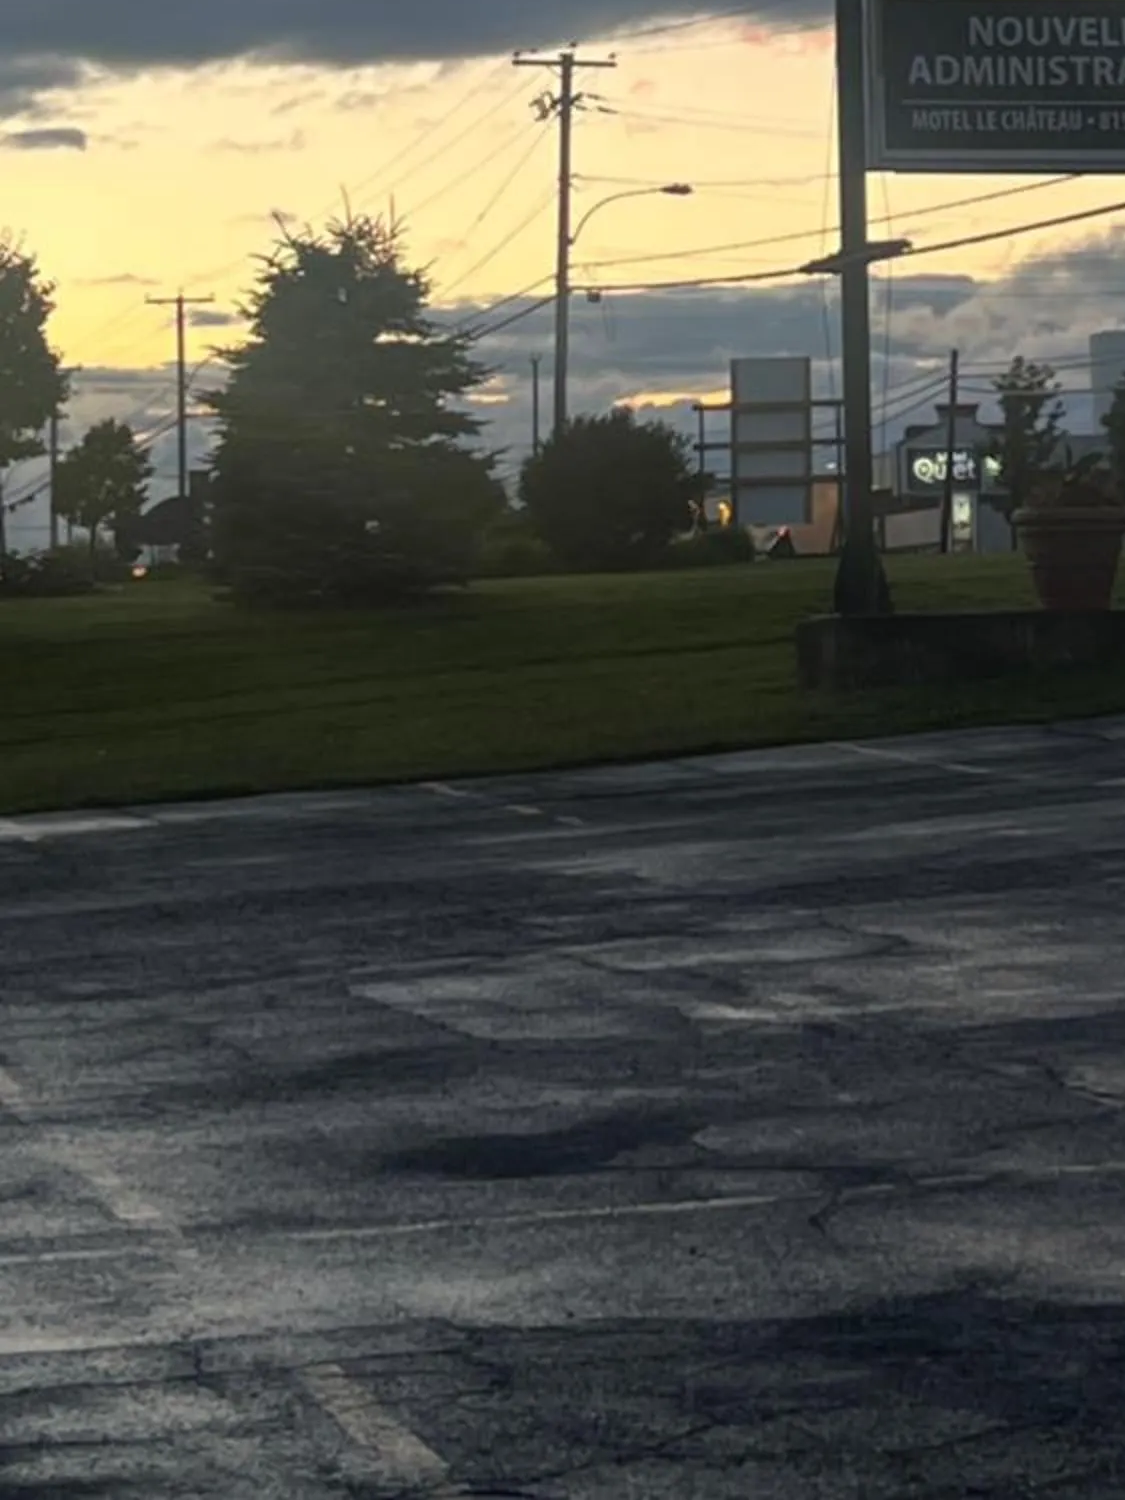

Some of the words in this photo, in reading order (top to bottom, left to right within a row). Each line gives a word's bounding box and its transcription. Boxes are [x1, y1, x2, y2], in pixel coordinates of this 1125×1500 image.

[911, 108, 971, 131] MOTEL
[976, 109, 998, 131] LE
[1001, 105, 1083, 131] CHÂTEAU
